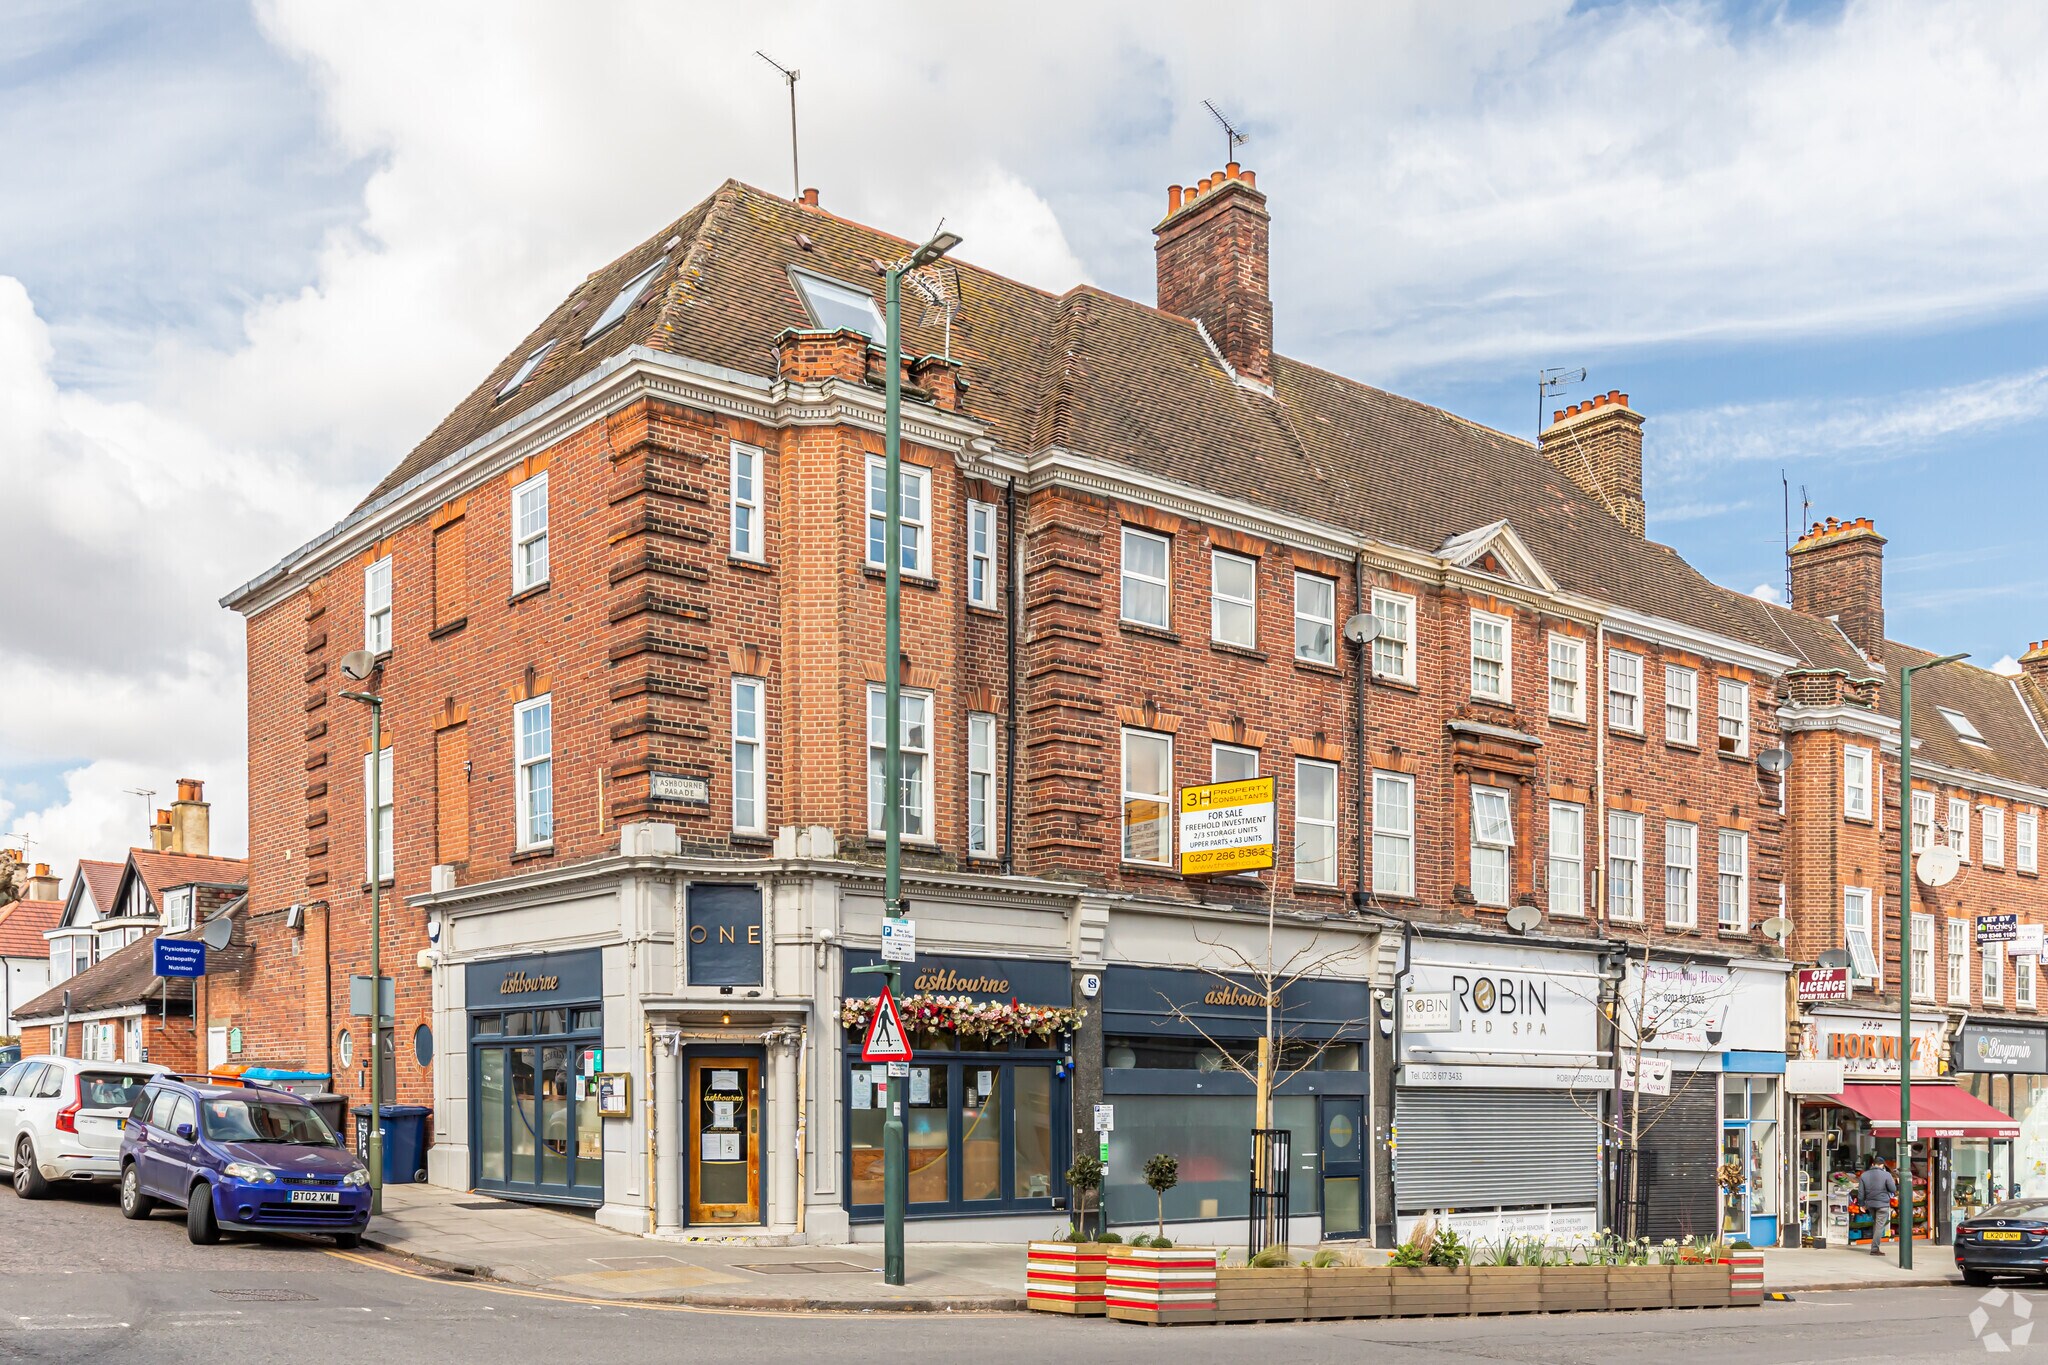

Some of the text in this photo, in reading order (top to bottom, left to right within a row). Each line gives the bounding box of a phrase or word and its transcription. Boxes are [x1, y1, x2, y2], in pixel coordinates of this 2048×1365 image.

[660, 779, 703, 790] ASHBOURNE
[1213, 784, 1269, 796] PROPERTY
[664, 788, 695, 797] PARADE
[1212, 792, 1269, 804] CONSULTANTS
[1208, 809, 1243, 820] FOR SALE
[1185, 816, 1267, 831] FREEHOLD INVESTMENT
[1193, 826, 1258, 840] 2/3 STORAGE UNITS
[1189, 840, 1209, 849] UPPER
[1210, 838, 1228, 846] PARTS
[1243, 835, 1262, 843] UNITS
[1188, 853, 1214, 863] 0207
[1216, 851, 1236, 861] 286
[1986, 921, 2017, 932] Finchley's
[690, 924, 761, 944] ONE
[160, 945, 201, 955] Physiotherapy
[164, 954, 197, 963] Osteopathy
[168, 964, 193, 972] Nutrition
[914, 968, 1011, 994] ashbourne
[1410, 974, 1415, 985] 3
[1699, 970, 1725, 984] House
[1811, 969, 1834, 981] OFF
[500, 970, 559, 994] ashbourne
[1799, 980, 1846, 993] LICENCE
[1452, 975, 1548, 1016] ROBIN
[1406, 998, 1448, 1013] ROBIN
[1458, 1019, 1547, 1035] ED SPA
[1687, 1032, 1702, 1043] Food
[1988, 1037, 2032, 1063] Binyamin
[1421, 1071, 1437, 1081] 0208
[1437, 1072, 1448, 1081] 617
[1448, 1072, 1463, 1081] 3433
[703, 1092, 745, 1103] ashbourne
[293, 1191, 338, 1203] BT02 XWL
